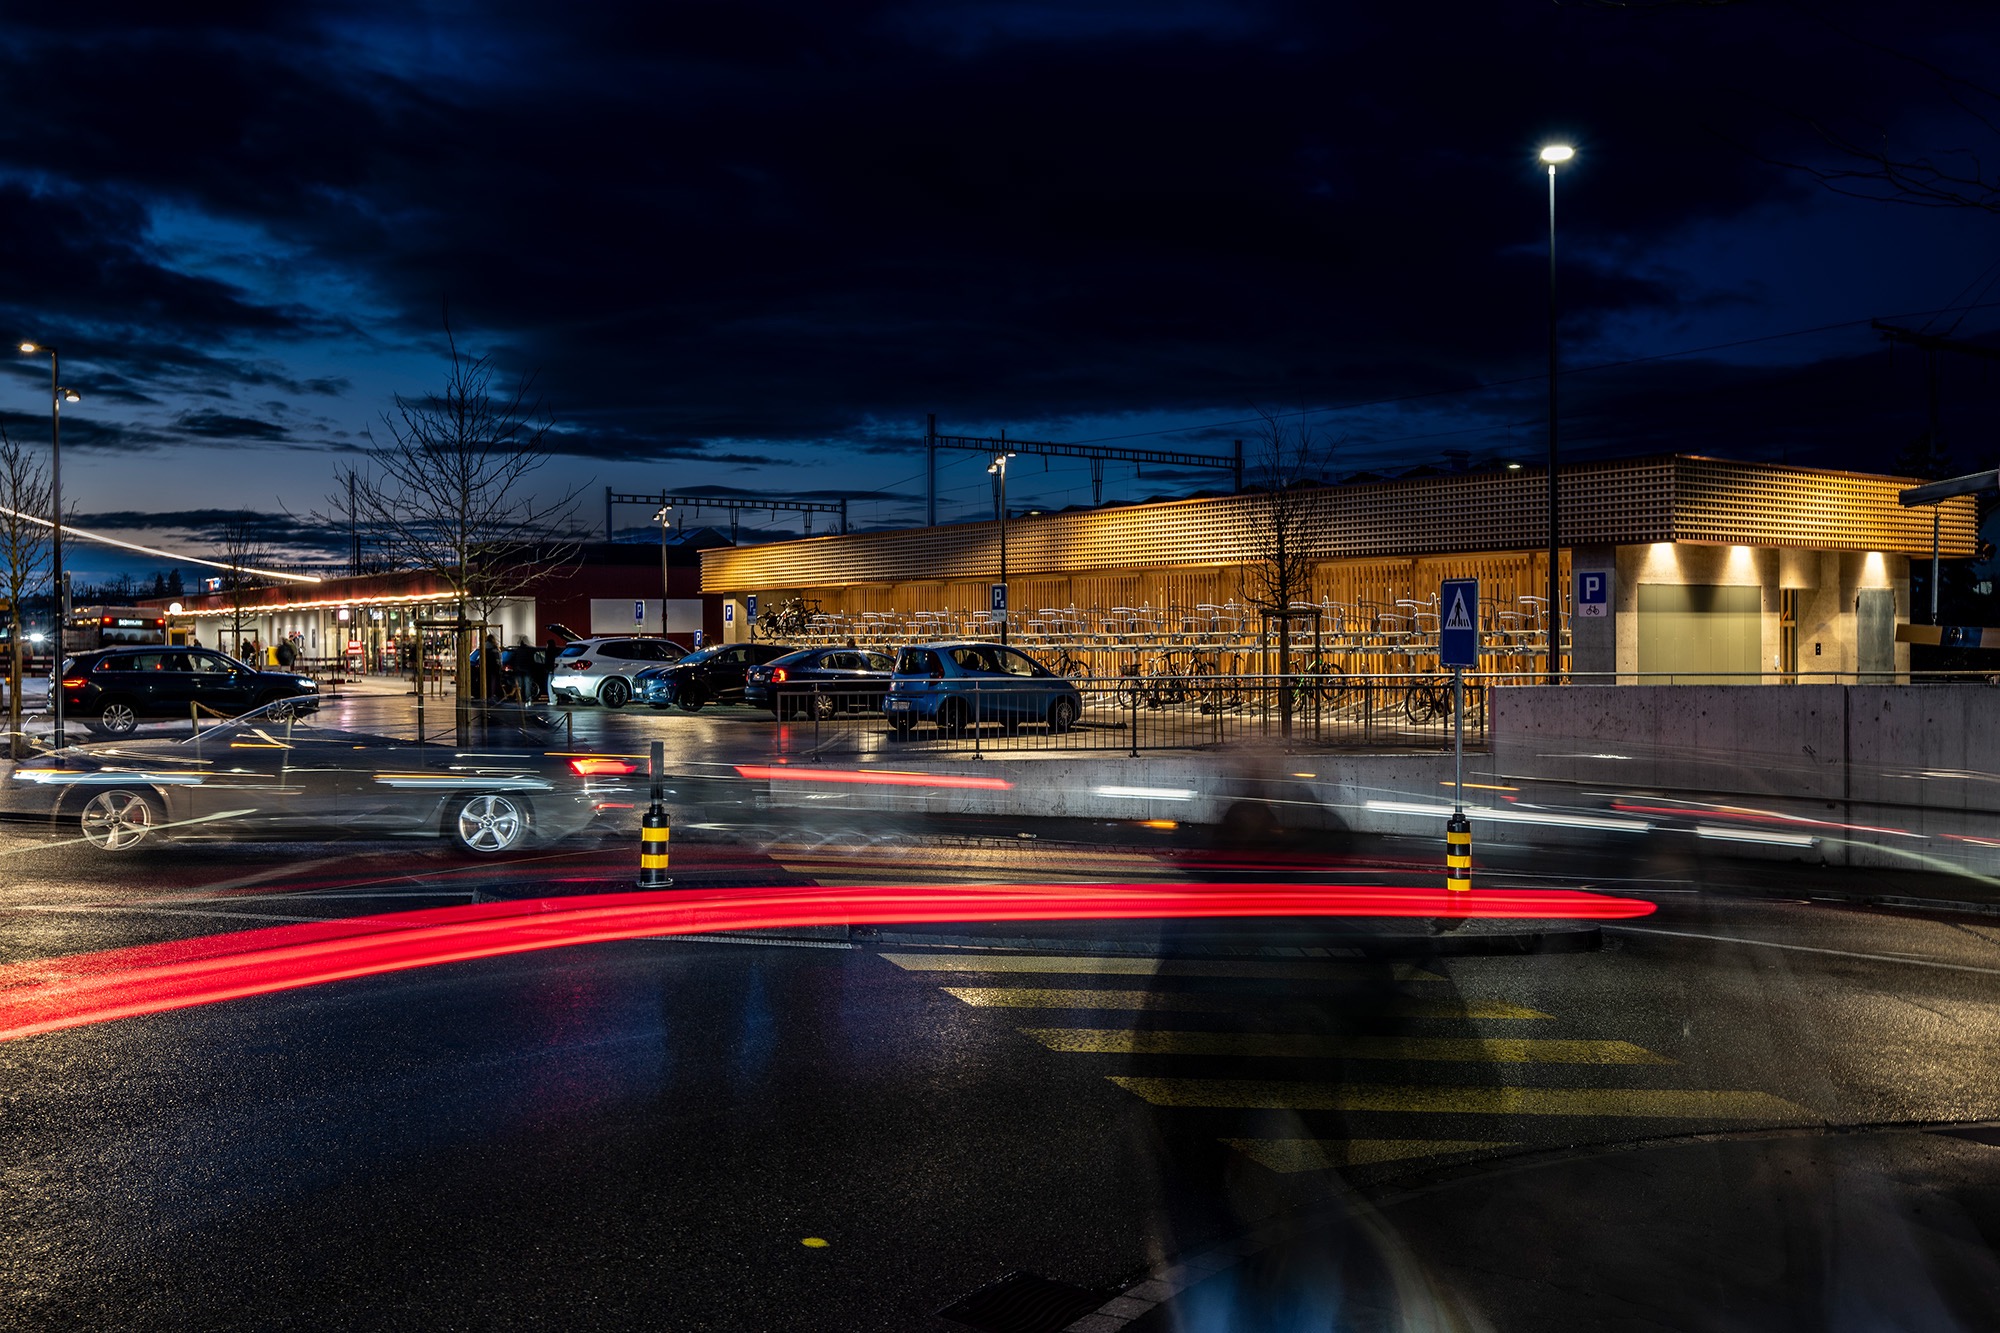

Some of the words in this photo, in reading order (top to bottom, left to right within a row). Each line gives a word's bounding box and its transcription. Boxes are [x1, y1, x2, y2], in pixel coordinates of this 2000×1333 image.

[1586, 576, 1600, 600] P
[994, 588, 1002, 606] P
[636, 604, 641, 616] P
[727, 606, 732, 620] P
[750, 600, 754, 614] P
[696, 634, 700, 645] P
